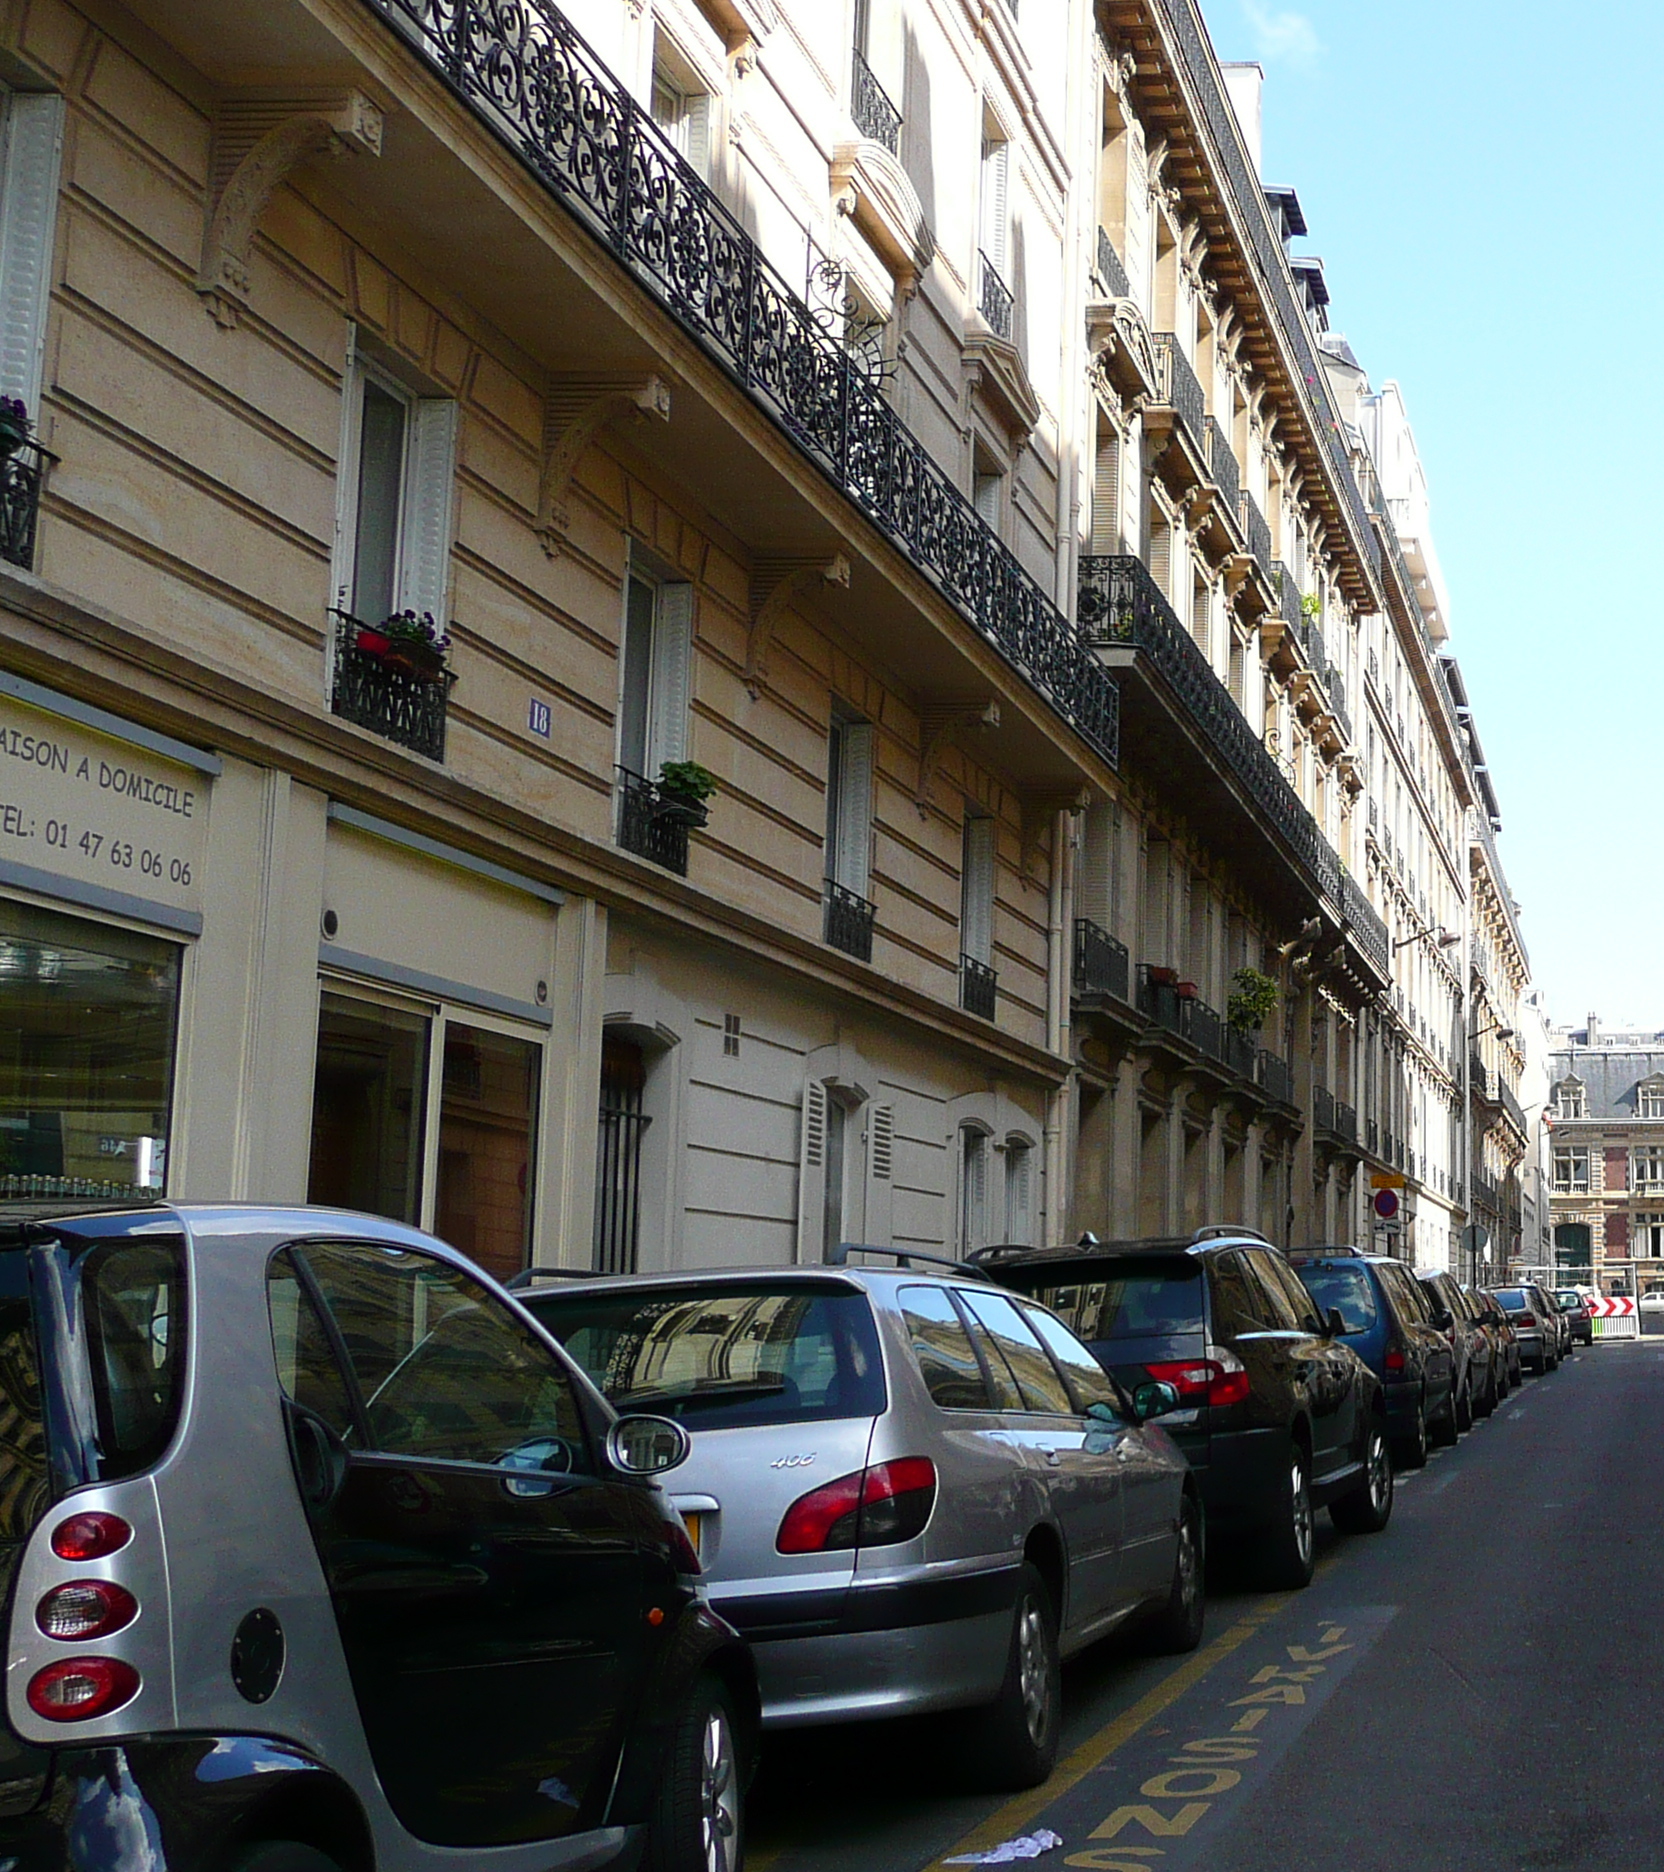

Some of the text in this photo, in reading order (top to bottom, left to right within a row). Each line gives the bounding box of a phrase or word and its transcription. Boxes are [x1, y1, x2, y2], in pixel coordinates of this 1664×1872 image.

[532, 702, 548, 733] 18
[76, 757, 90, 782] A
[99, 761, 195, 818] DOMICILE
[46, 820, 68, 848] 01
[79, 831, 104, 858] 47
[111, 840, 133, 868] 63
[140, 850, 163, 877] 06
[170, 859, 192, 886] 06
[770, 1451, 817, 1470] 406
